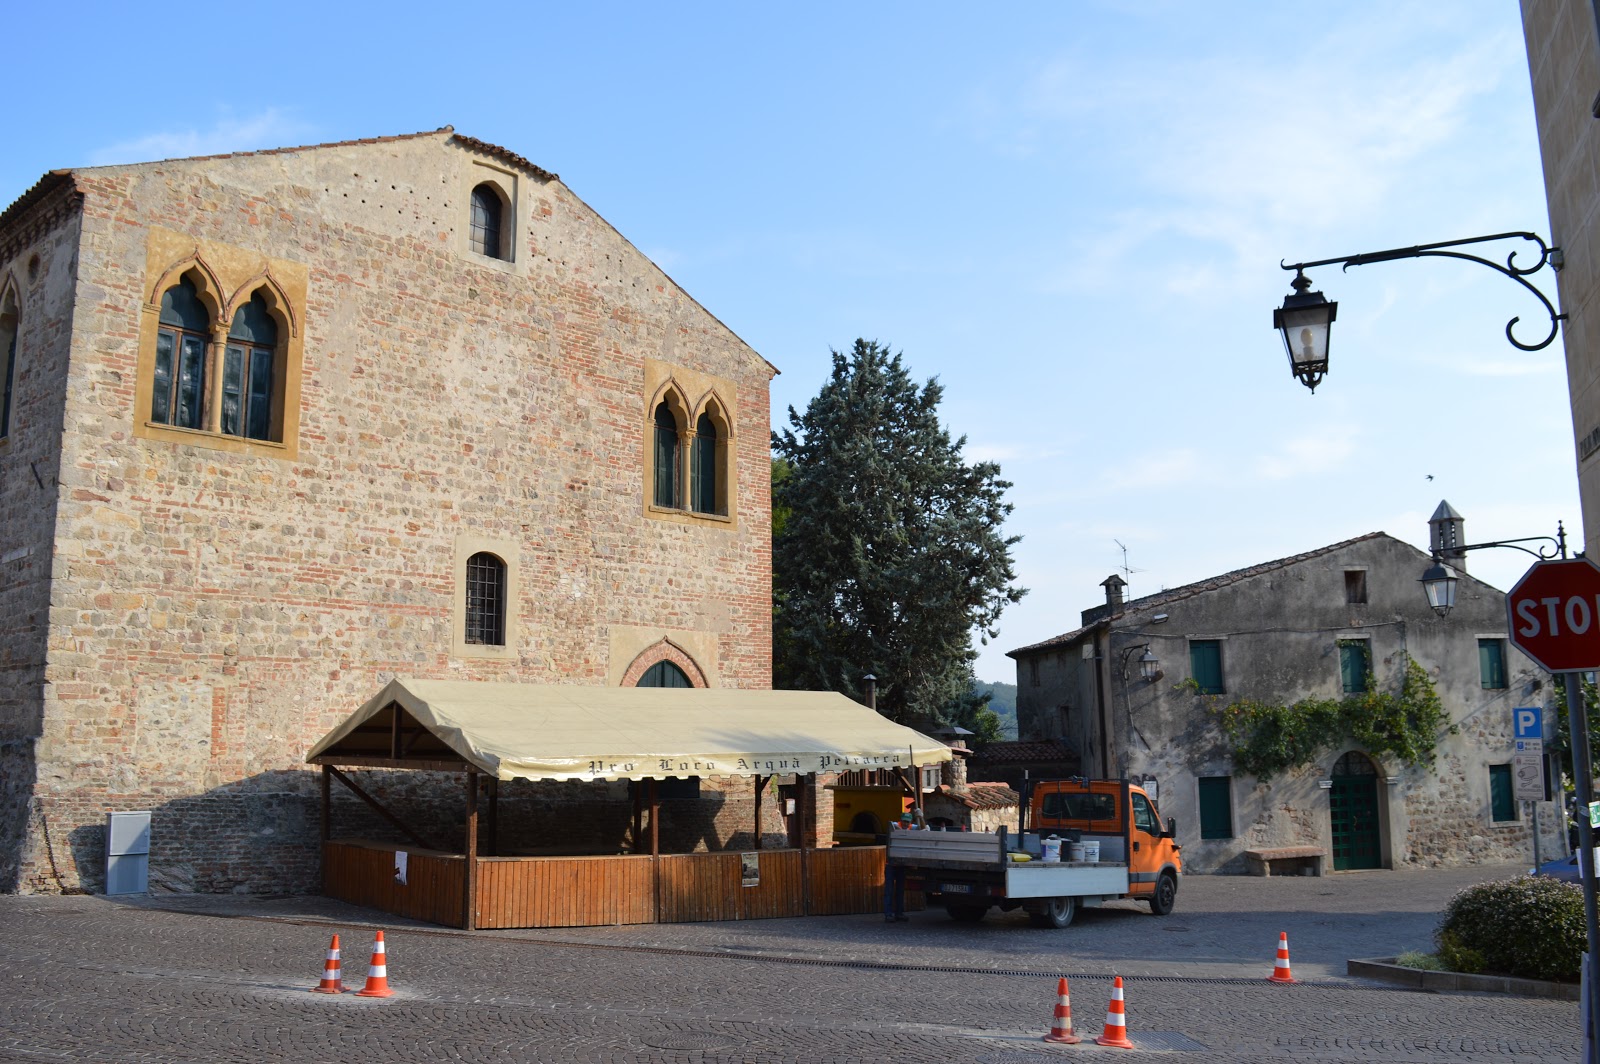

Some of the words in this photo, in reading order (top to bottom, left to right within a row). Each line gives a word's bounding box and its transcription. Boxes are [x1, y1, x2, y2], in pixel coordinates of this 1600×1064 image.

[1517, 594, 1600, 638] STO
[1518, 711, 1536, 736] P
[589, 760, 634, 776] Pro
[659, 758, 715, 771] Loco
[737, 757, 801, 772] Arquà
[819, 755, 900, 769] Petrarca
